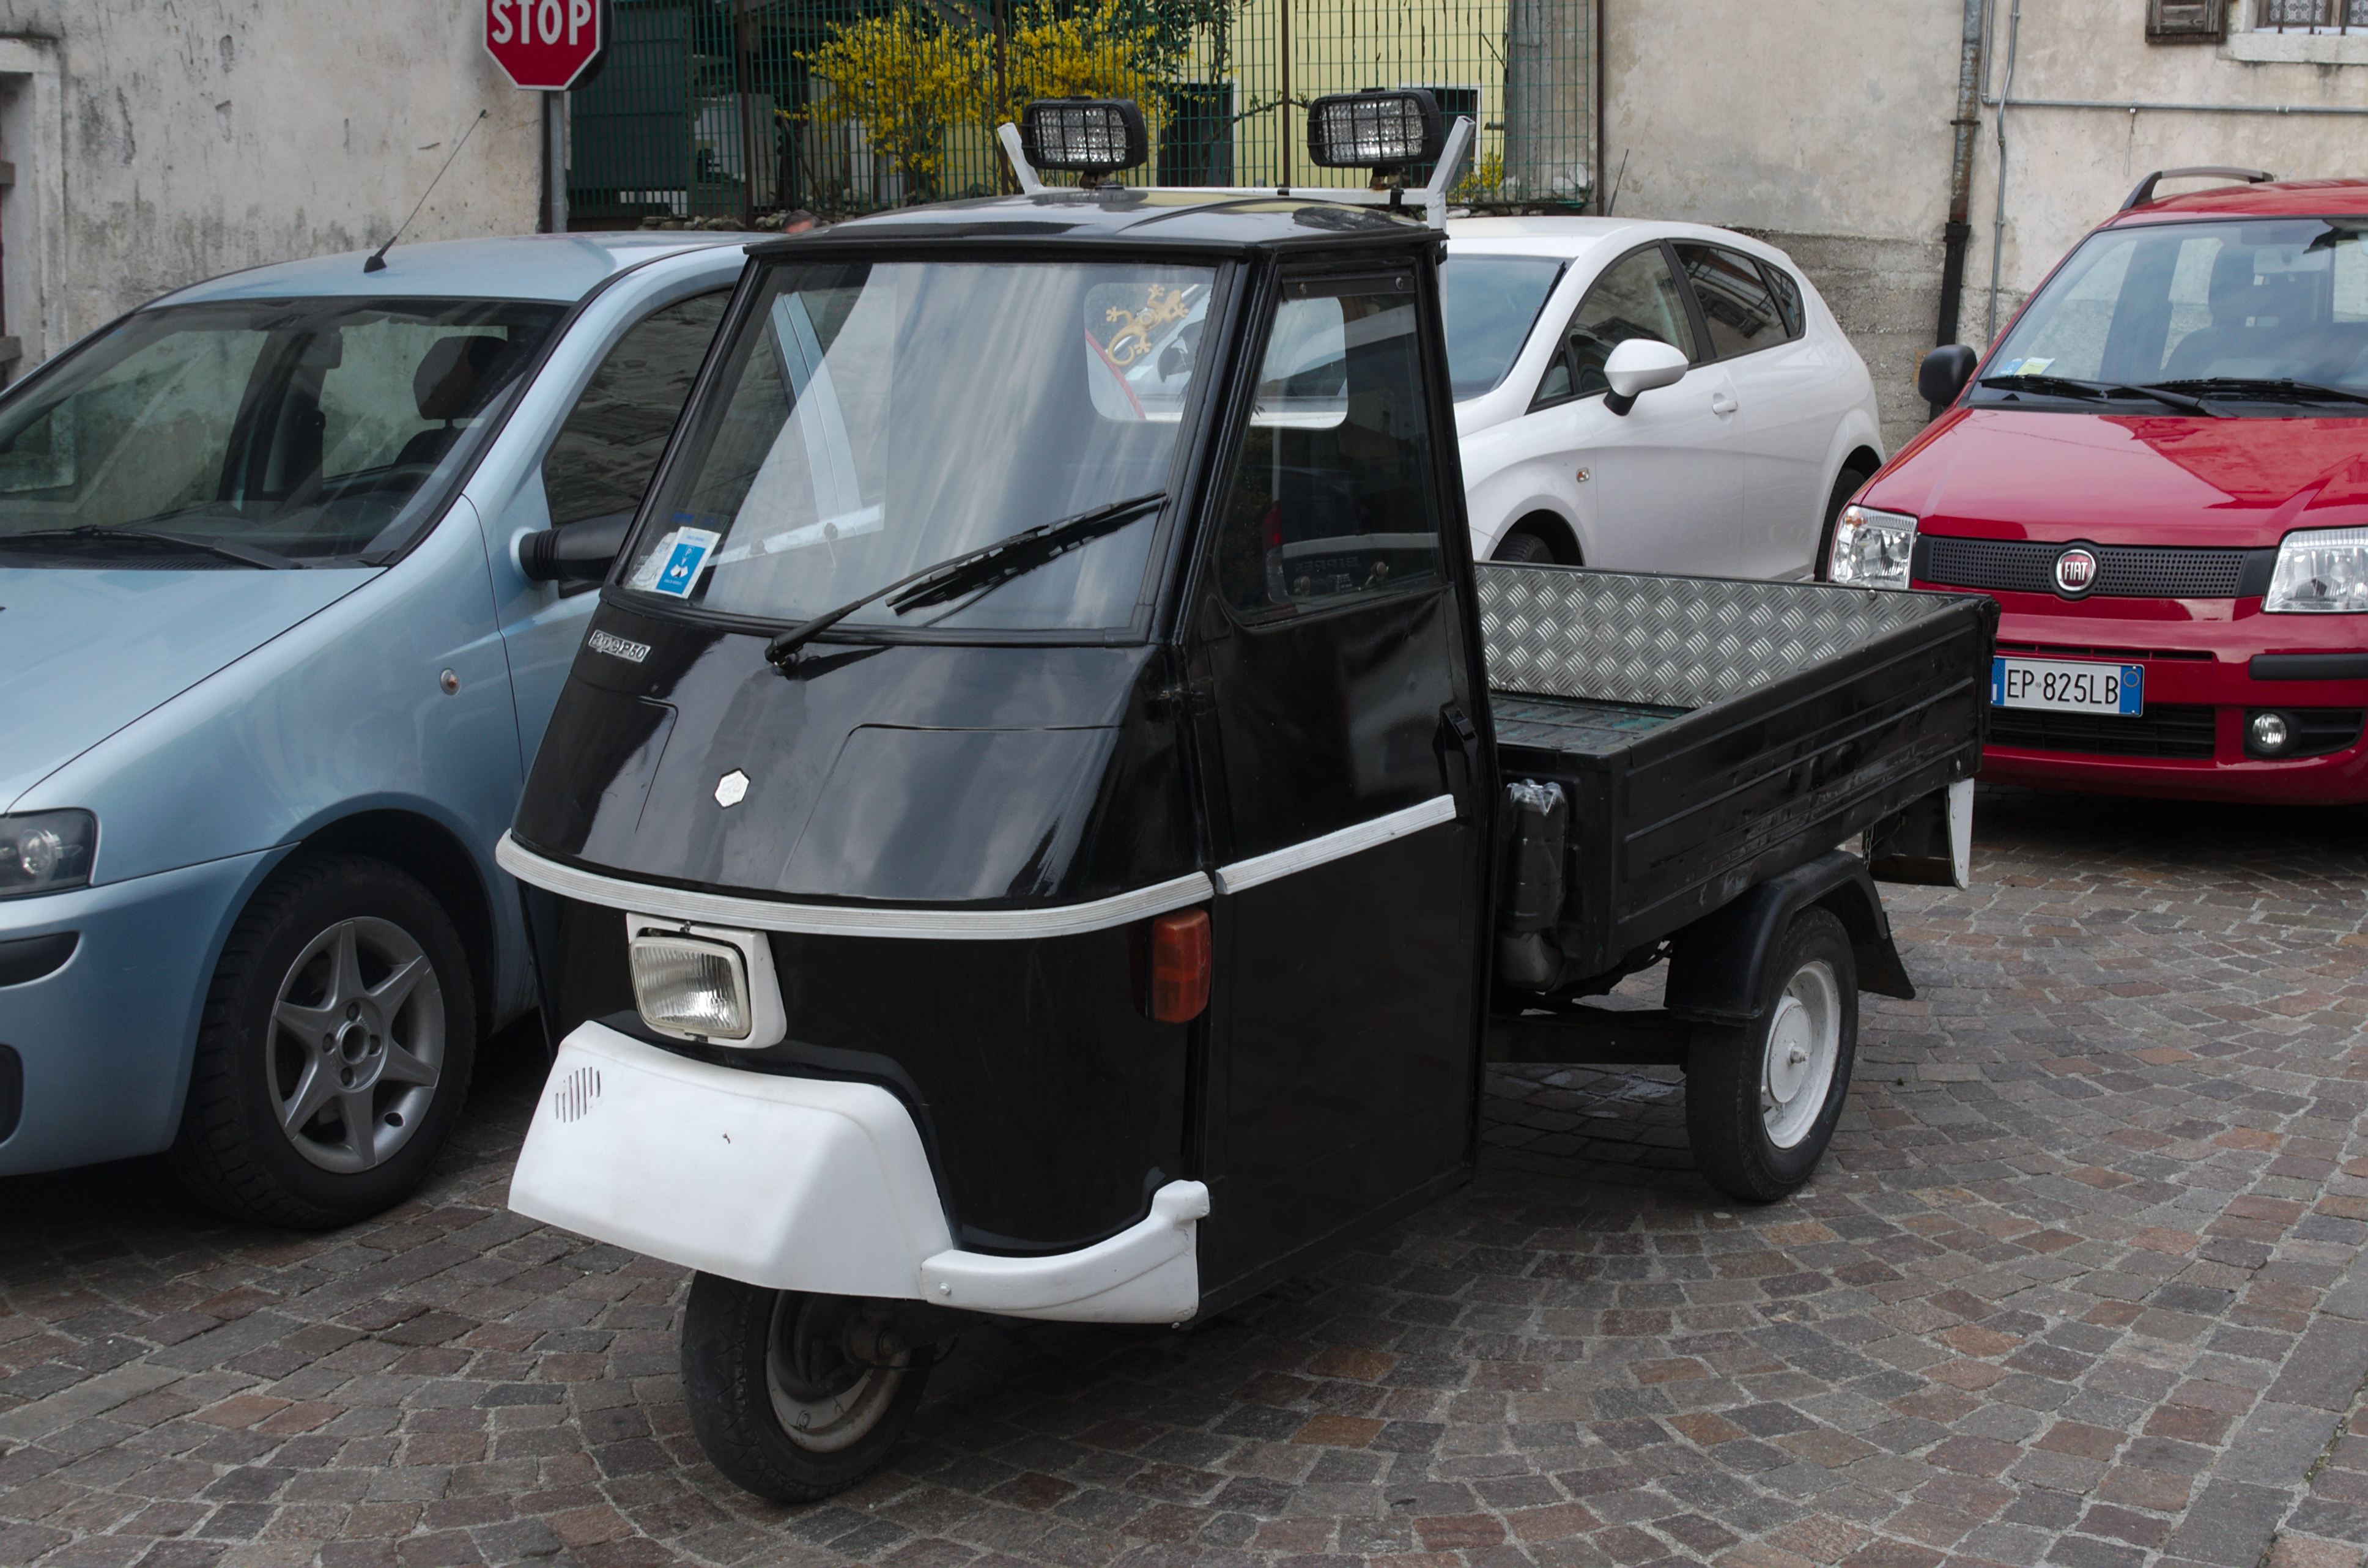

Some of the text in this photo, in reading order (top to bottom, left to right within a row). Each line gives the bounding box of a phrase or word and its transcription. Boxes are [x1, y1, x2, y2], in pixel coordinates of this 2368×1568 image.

[492, 0, 591, 45] STOP
[2064, 561, 2088, 580] FIAT
[2007, 668, 2118, 704] EP 825LB
